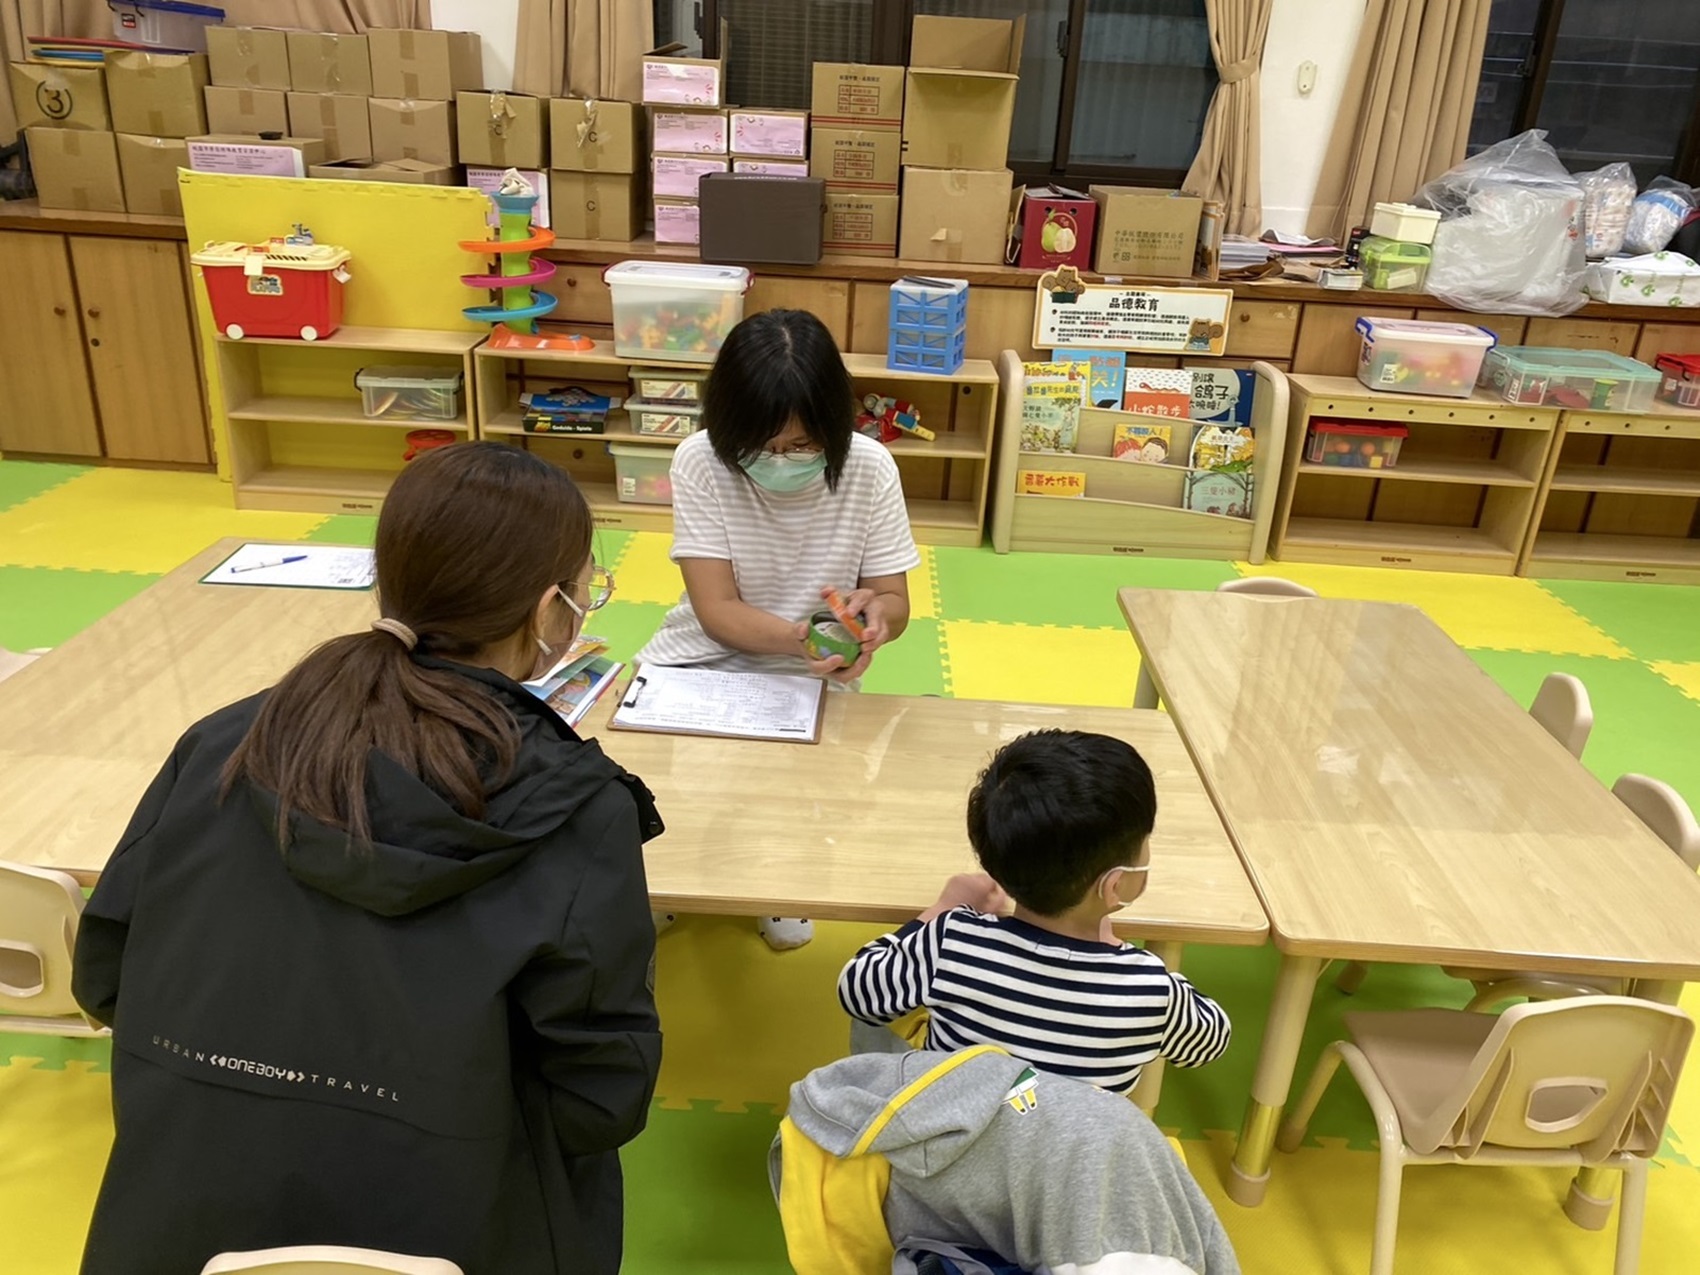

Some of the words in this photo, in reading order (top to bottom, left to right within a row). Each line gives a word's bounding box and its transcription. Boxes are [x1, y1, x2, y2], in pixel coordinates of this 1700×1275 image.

[588, 131, 598, 143] C
[586, 200, 596, 212] C
[1109, 297, 1160, 312] 品德教育
[1192, 372, 1215, 384] 別讓
[1194, 384, 1229, 400] 鴿子
[152, 1034, 205, 1063] URBAN
[227, 1057, 287, 1081] ONEBOY
[311, 1073, 399, 1102] TRAVEL
